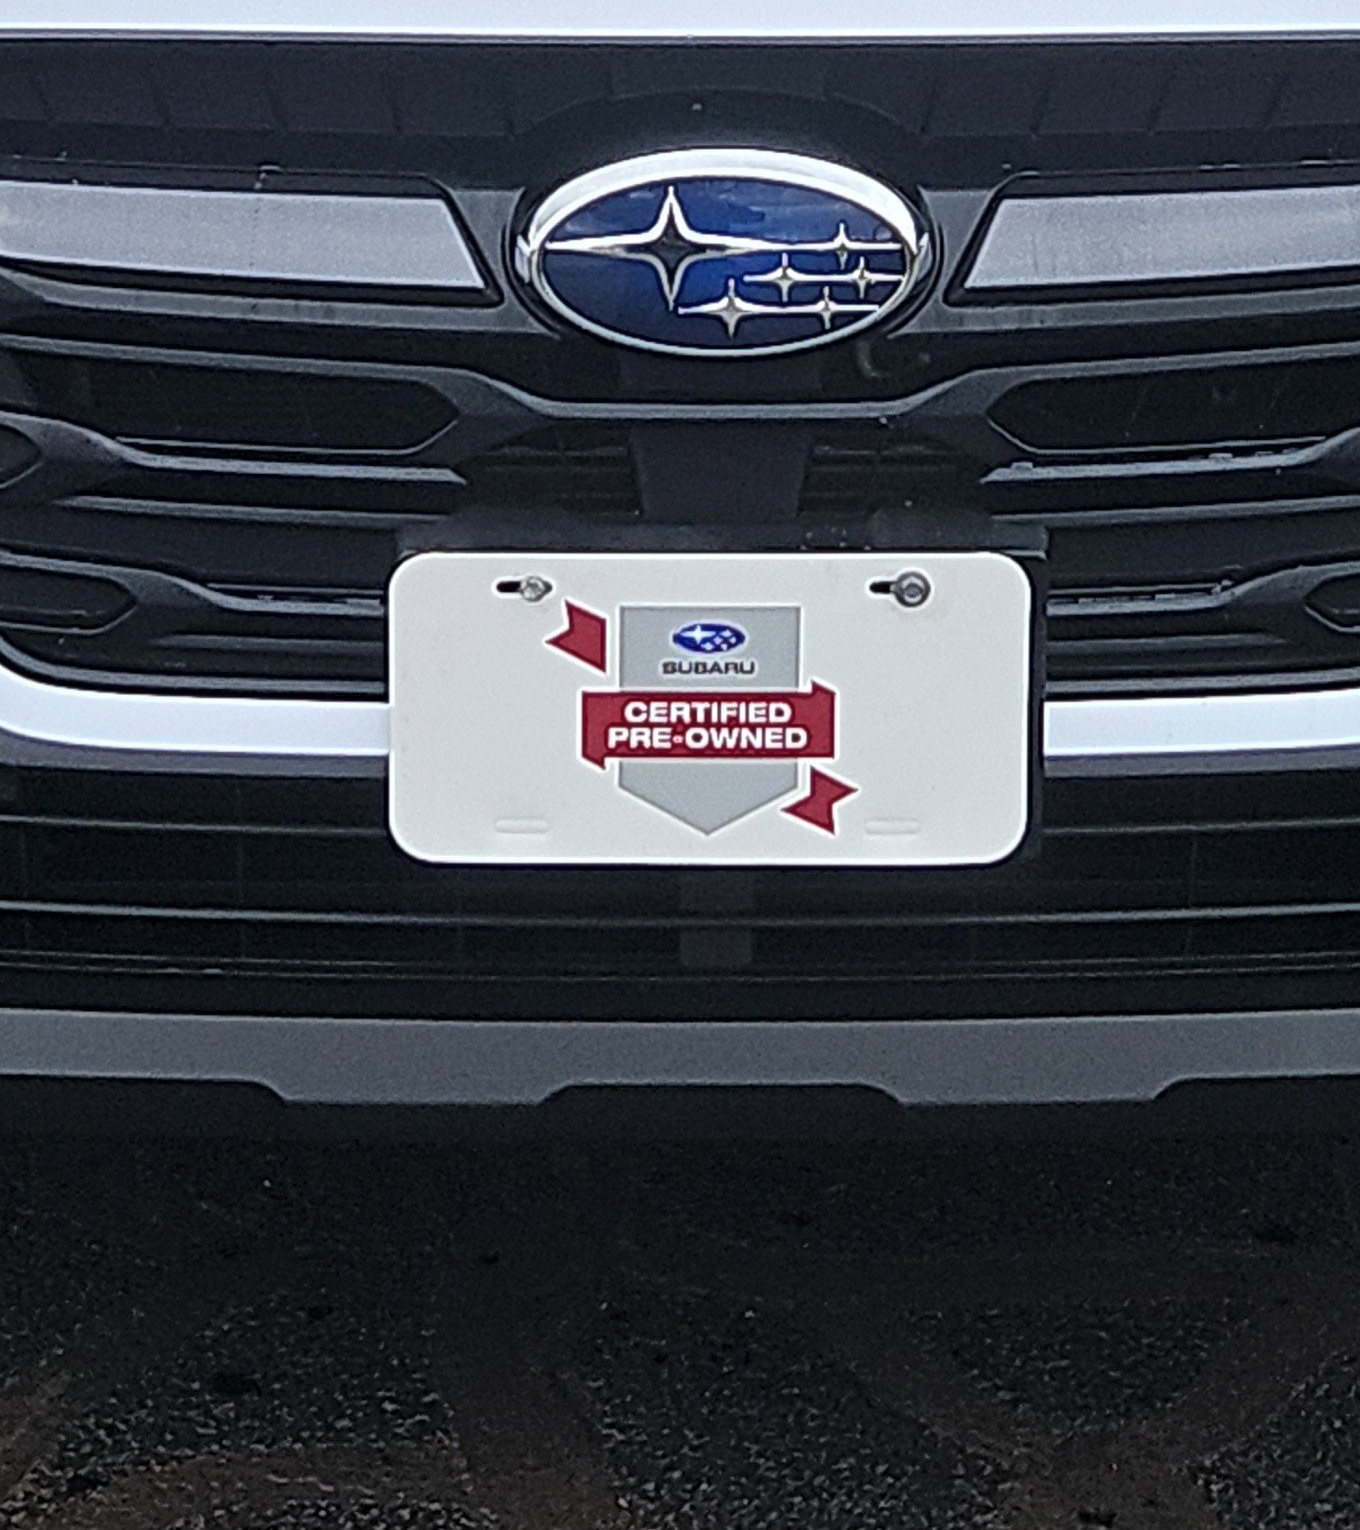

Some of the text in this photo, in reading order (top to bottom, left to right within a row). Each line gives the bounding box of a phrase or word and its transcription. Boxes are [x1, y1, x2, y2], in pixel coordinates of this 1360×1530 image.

[661, 660, 756, 675] SUBARU
[624, 700, 793, 724] CERTIFIED
[607, 726, 809, 750] PRE-OWNED
